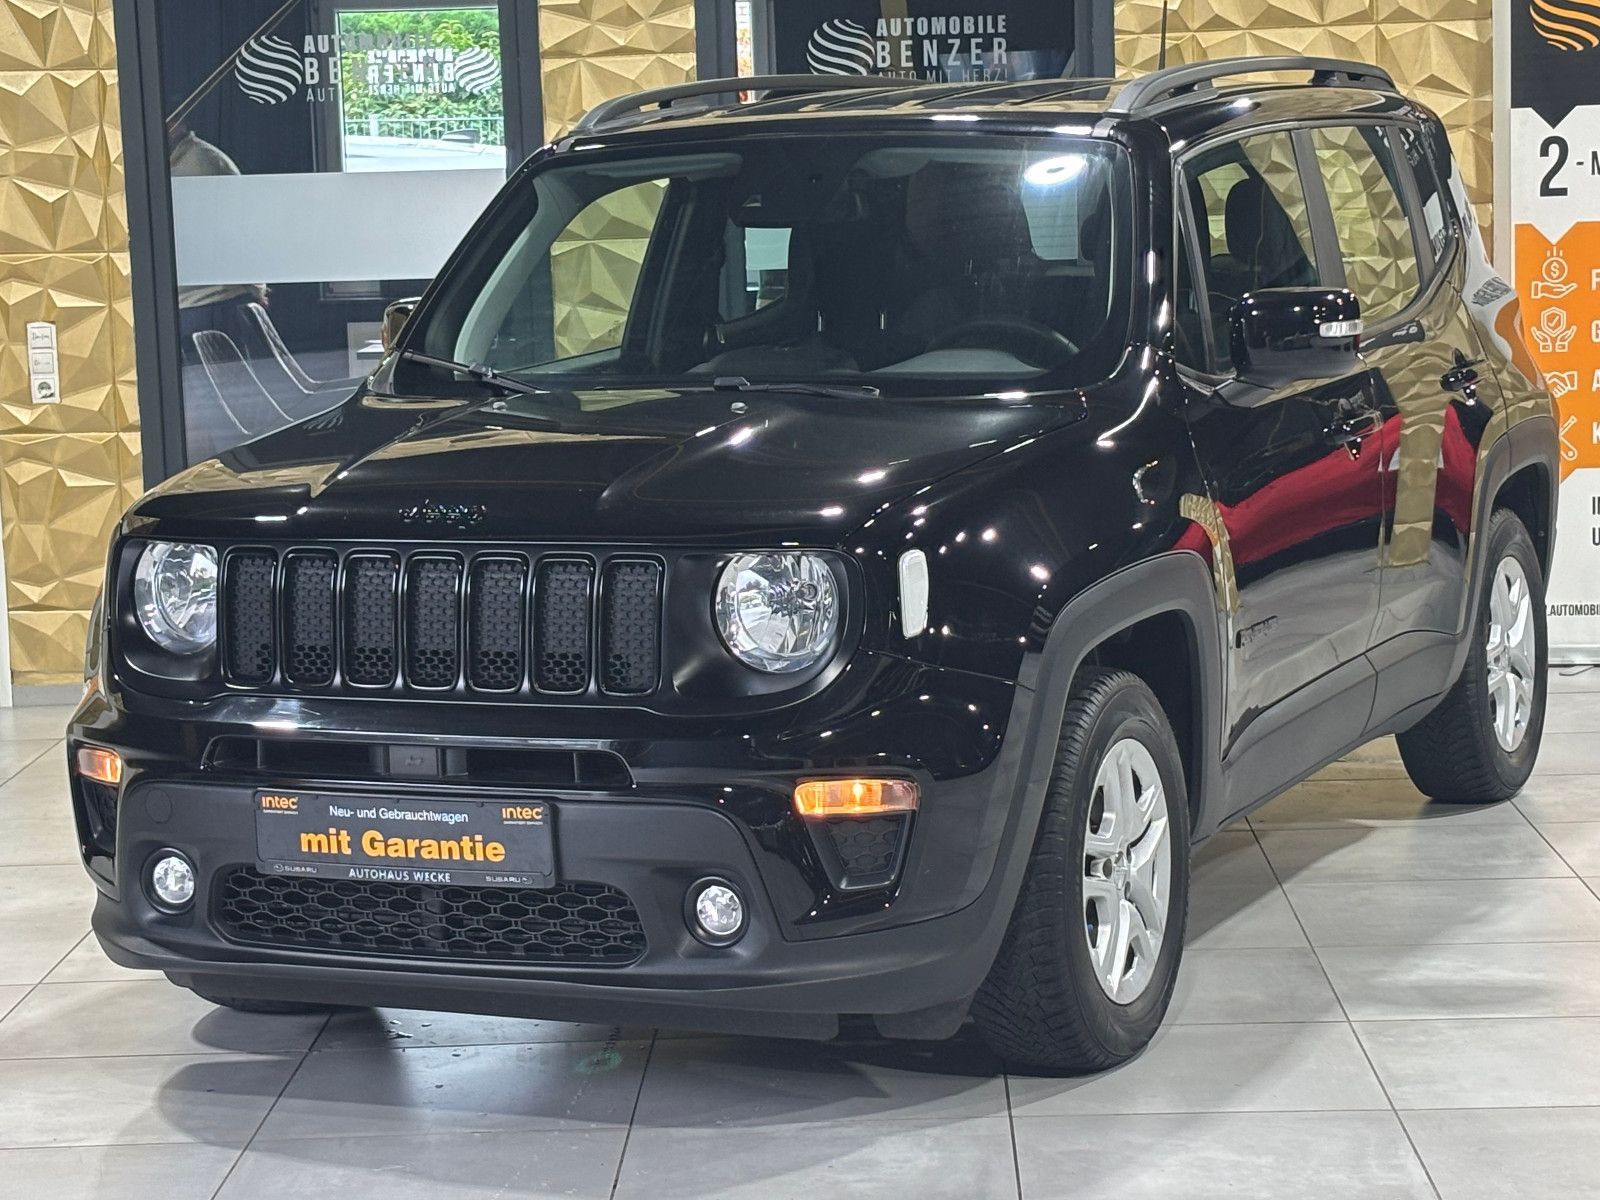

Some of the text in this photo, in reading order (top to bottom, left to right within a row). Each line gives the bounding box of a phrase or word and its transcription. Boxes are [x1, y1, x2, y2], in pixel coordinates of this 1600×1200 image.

[876, 14, 1007, 37] AUTOMOBILE
[876, 37, 1007, 68] BENZER
[329, 805, 469, 825] Neu- und Gebrauchtwagen
[300, 827, 506, 863] mit Garantie
[284, 865, 318, 874] SUBARU
[348, 868, 410, 881] AUTOHAUS
